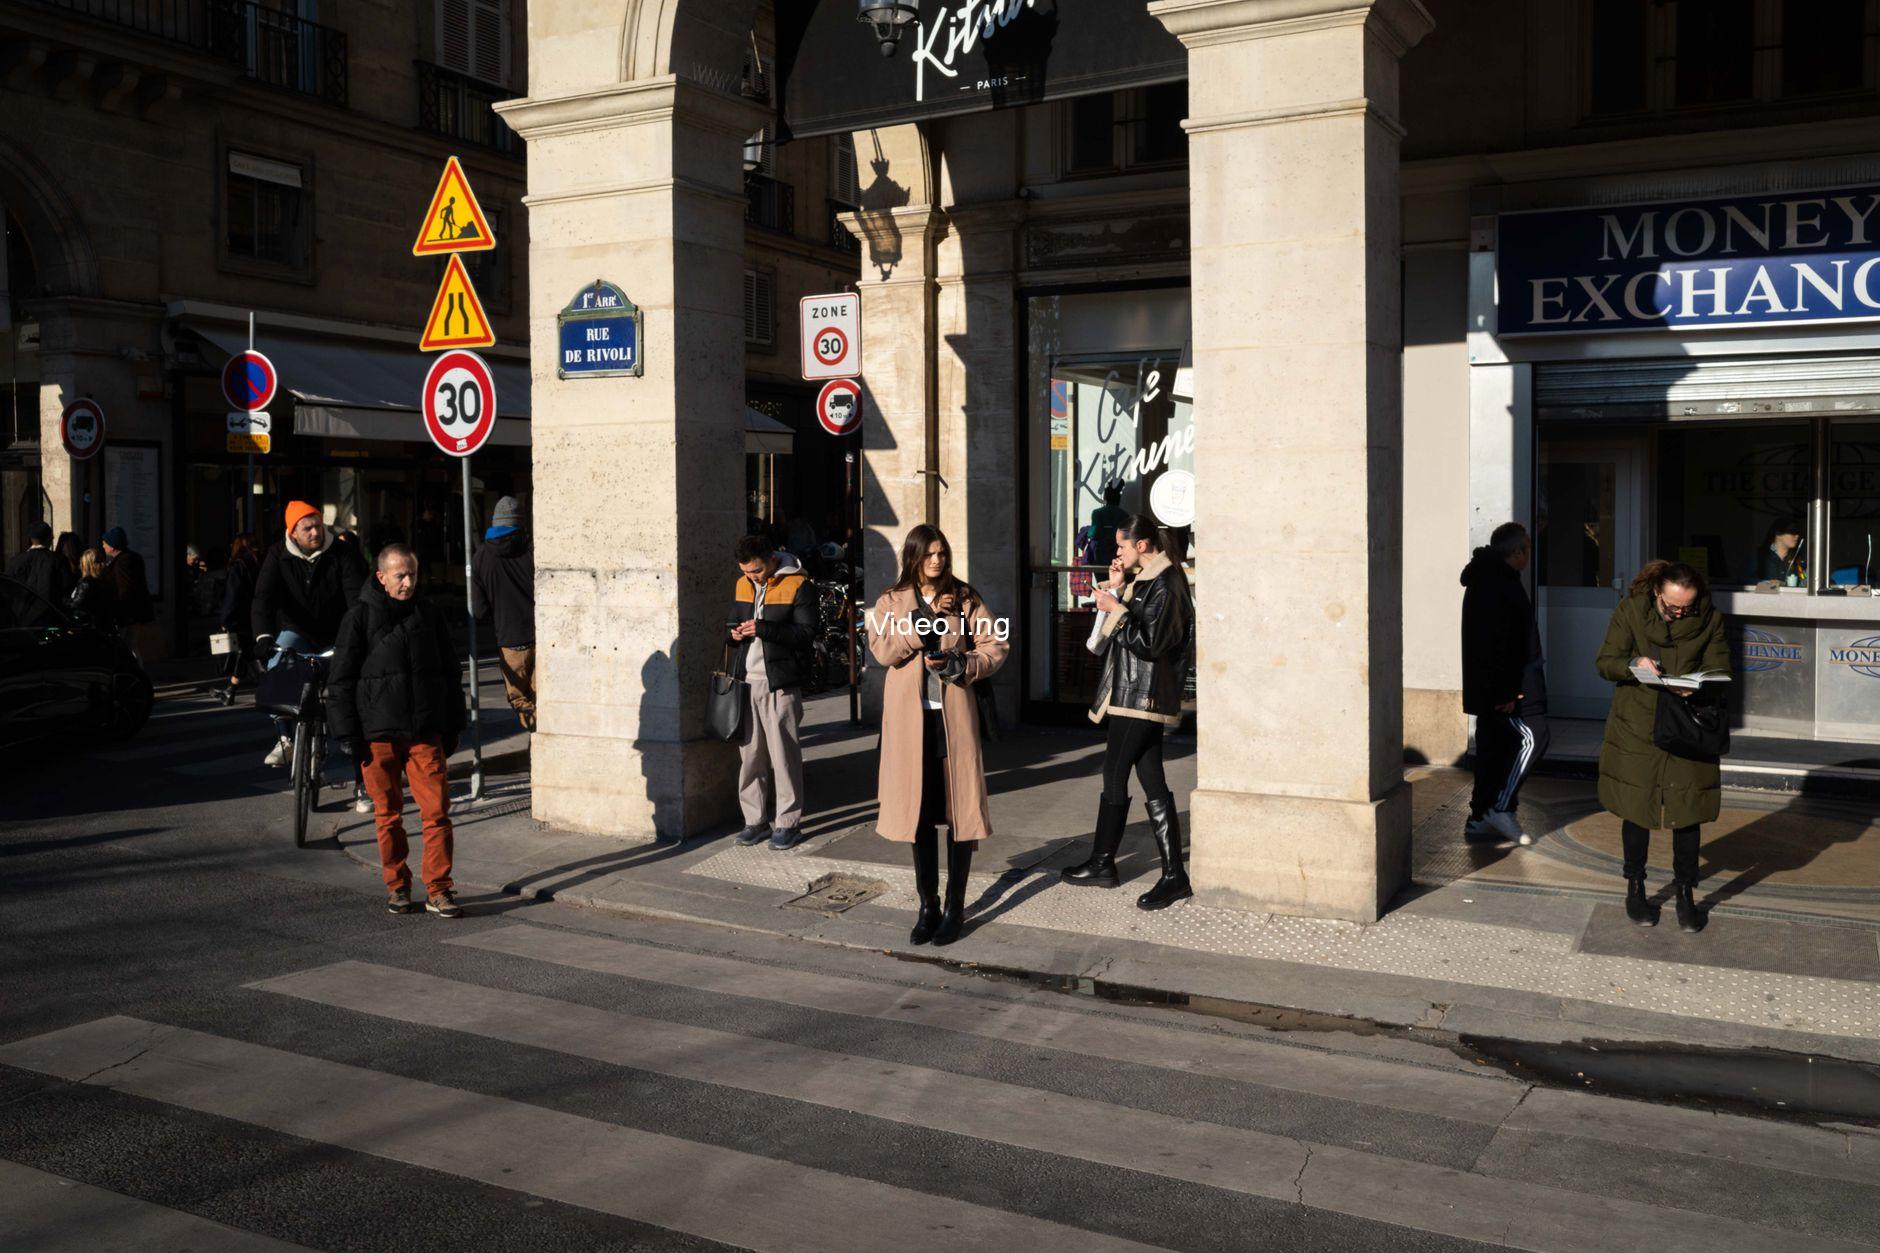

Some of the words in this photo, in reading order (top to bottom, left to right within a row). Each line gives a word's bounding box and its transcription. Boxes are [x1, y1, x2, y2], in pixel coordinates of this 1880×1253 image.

[912, 0, 1034, 101] Kitsu
[977, 77, 1008, 90] PARIS
[1598, 195, 1880, 261] MONEY
[812, 305, 847, 319] ZONE
[586, 327, 609, 341] RUE
[565, 349, 581, 363] DE
[587, 347, 631, 362] RIVOLI
[820, 338, 841, 354] 30
[438, 380, 481, 426] 30
[1098, 358, 1161, 443] Café
[1703, 471, 1754, 491] THE
[1763, 471, 1875, 491] CHGE
